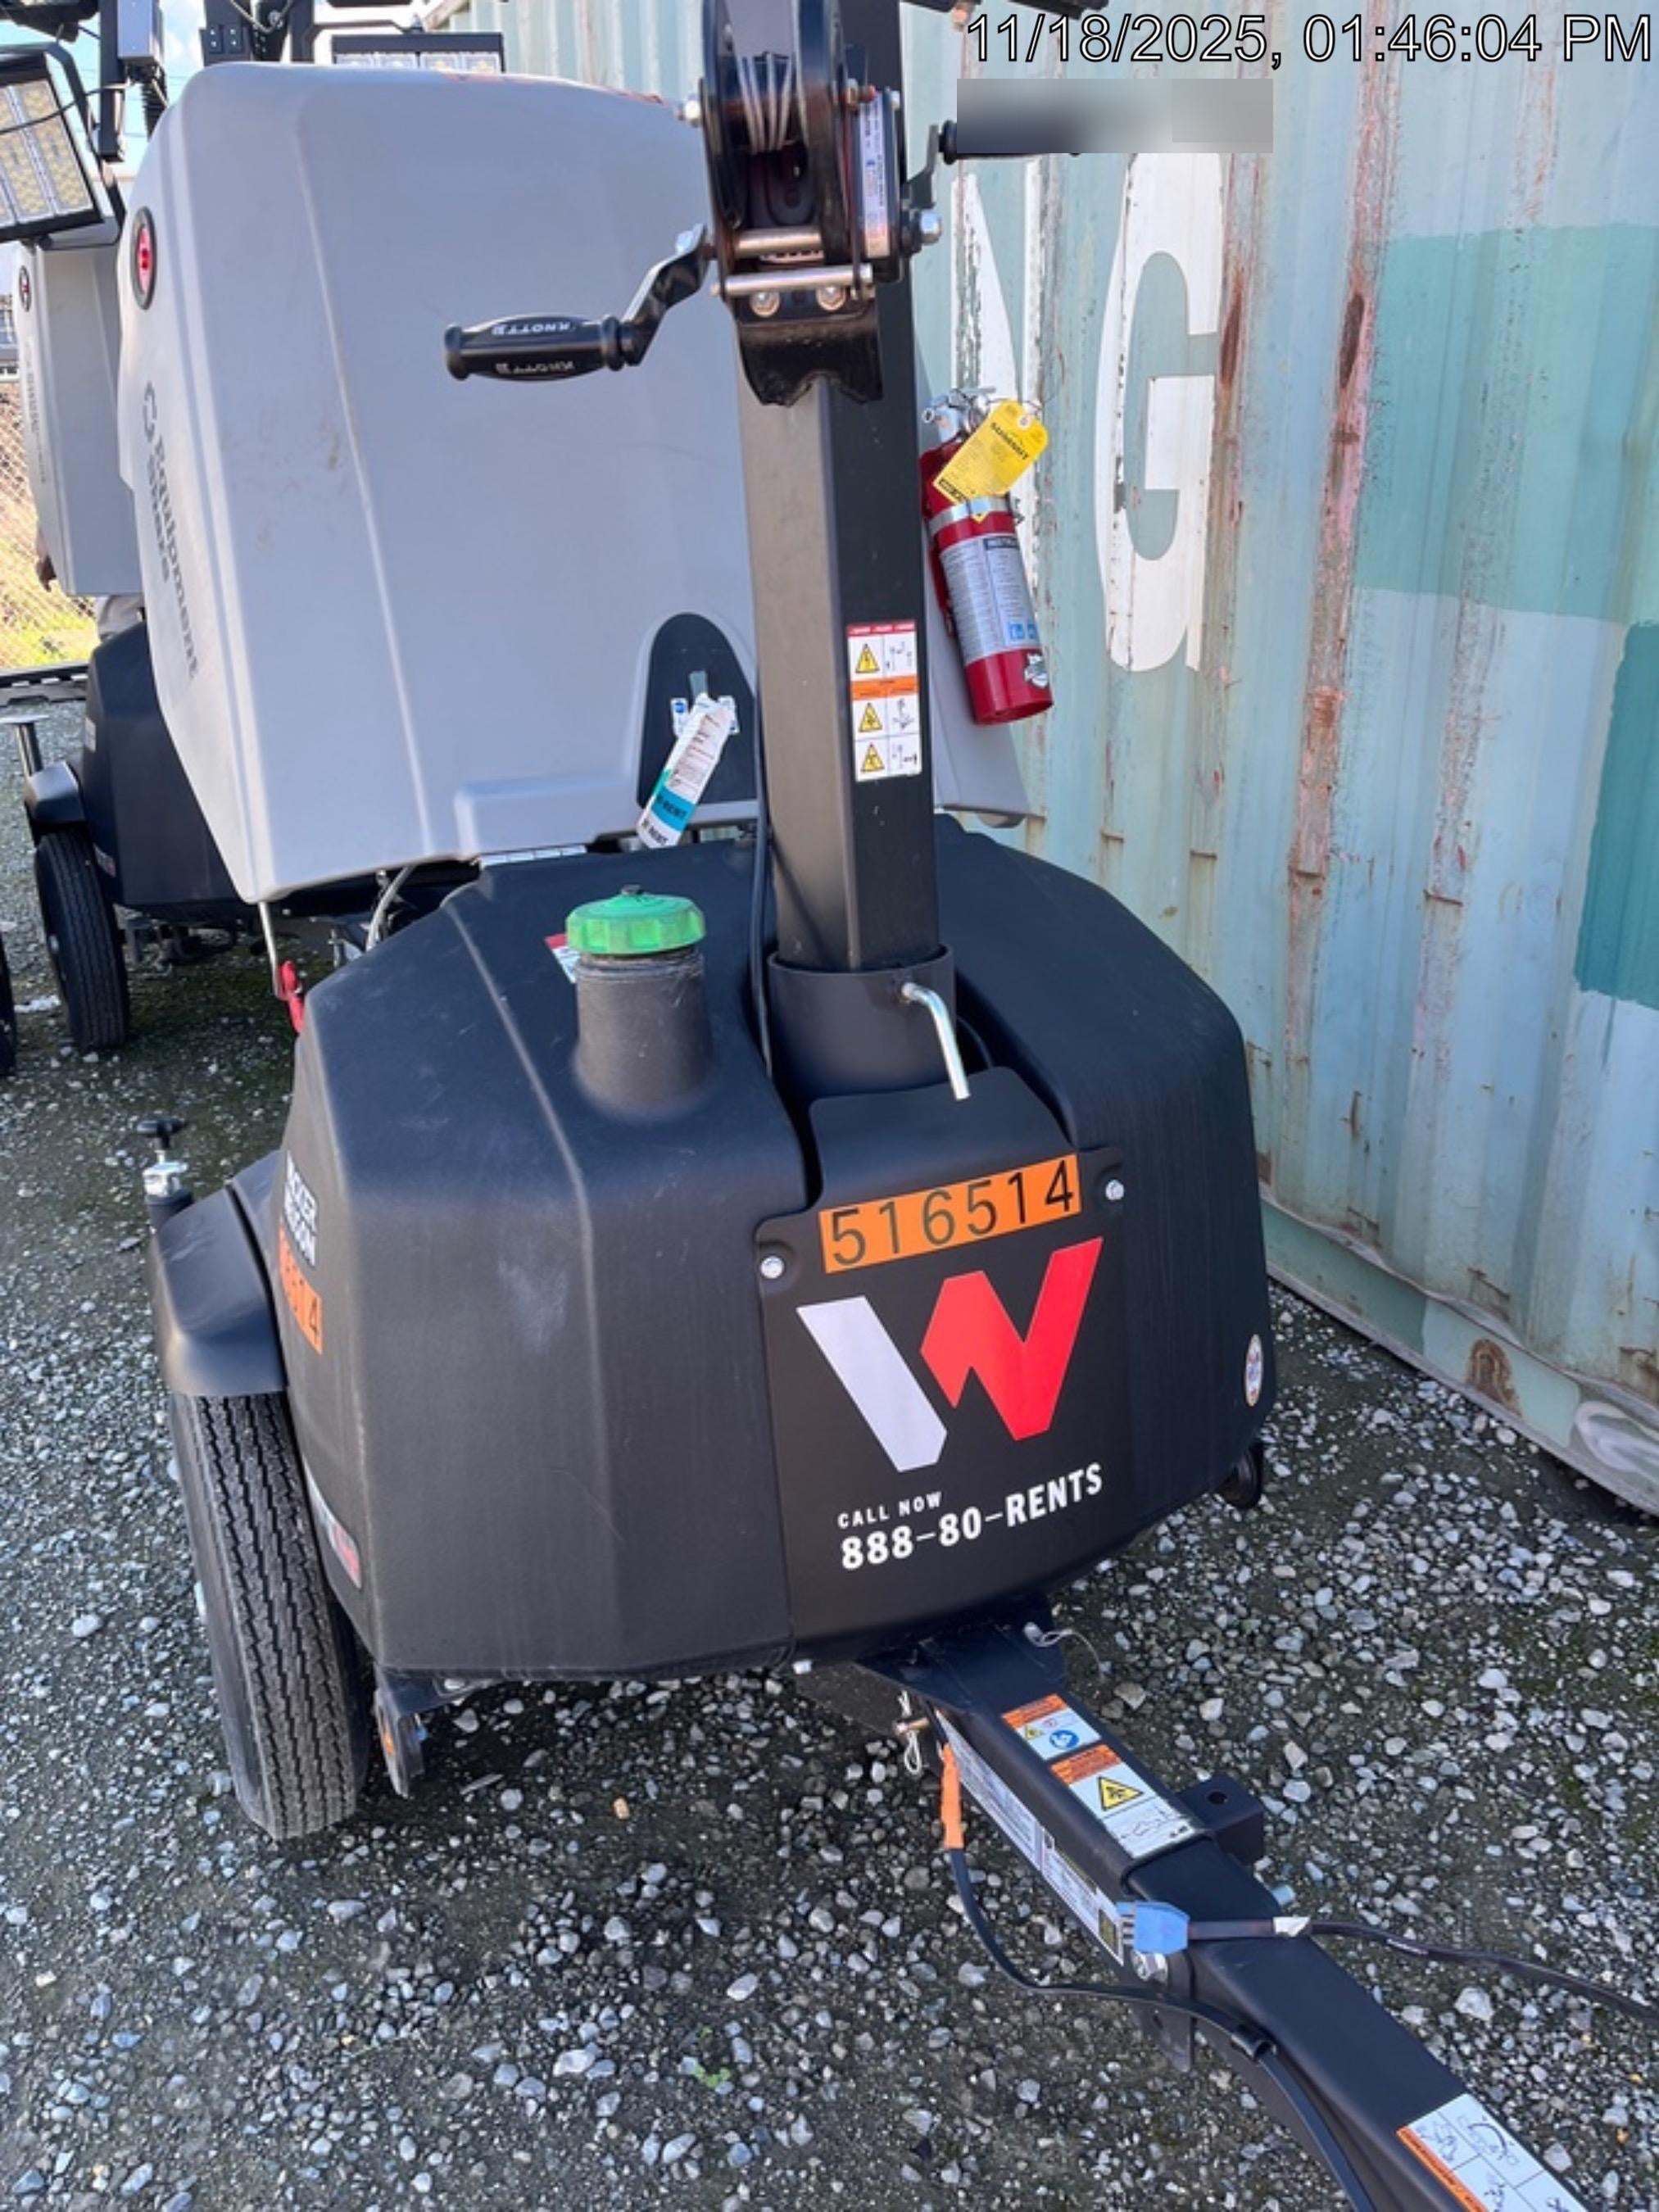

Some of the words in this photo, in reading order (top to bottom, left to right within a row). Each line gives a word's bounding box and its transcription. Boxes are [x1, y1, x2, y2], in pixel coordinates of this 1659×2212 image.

[832, 1159, 1074, 1266] 516514
[836, 1505, 891, 1530] CALL
[898, 1491, 942, 1516] NOW
[840, 1462, 1103, 1571] 888-80-RENTS
